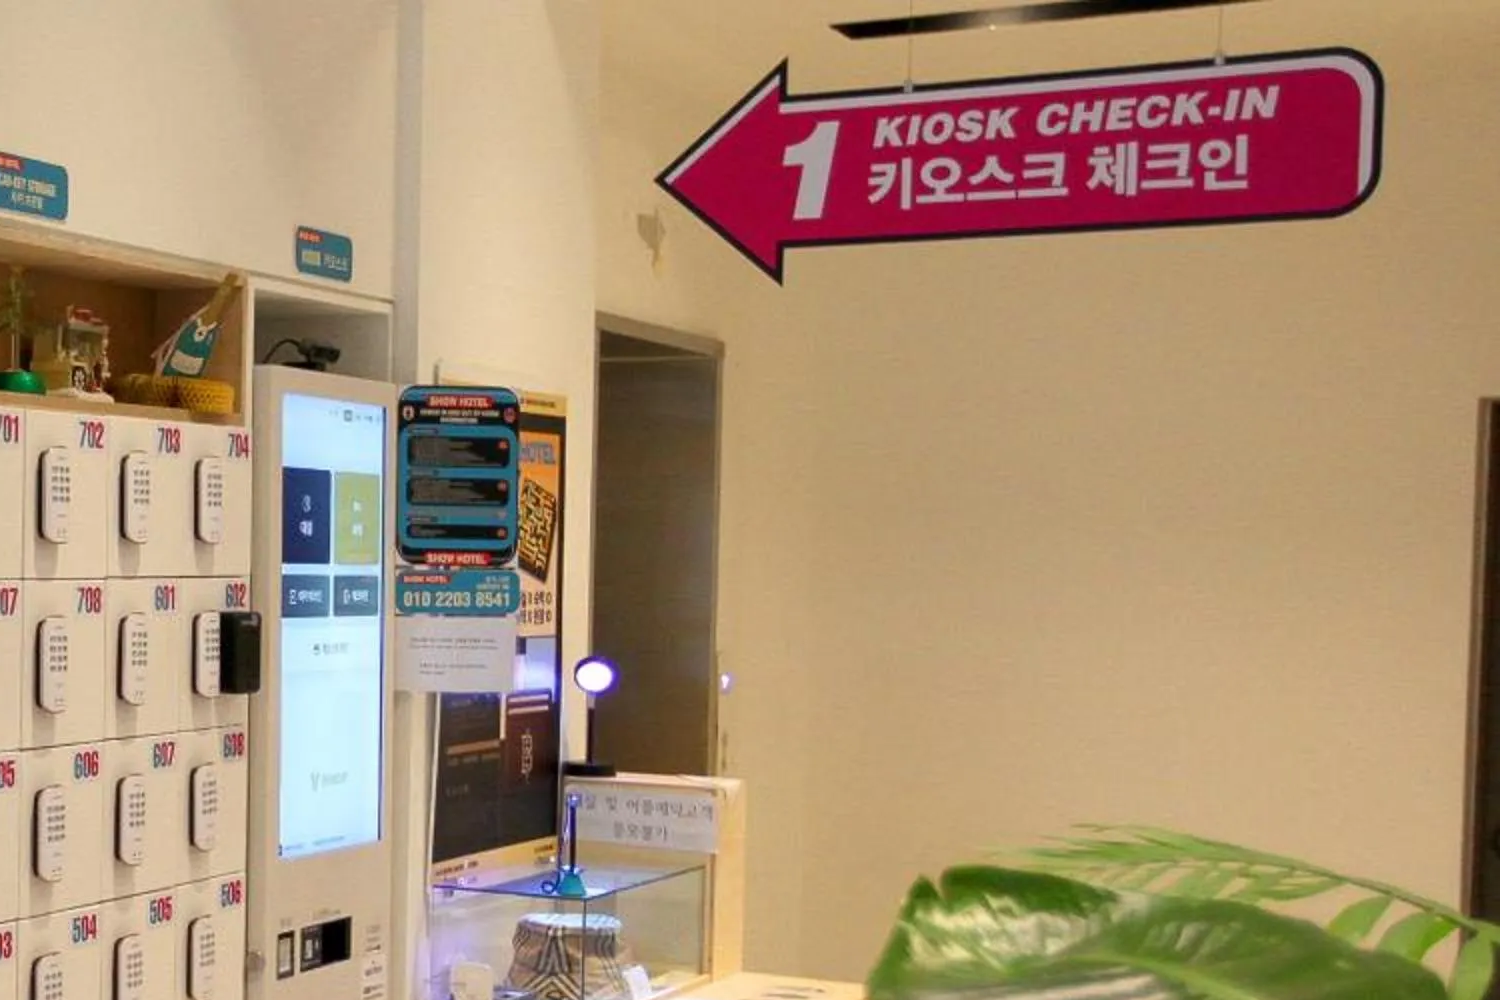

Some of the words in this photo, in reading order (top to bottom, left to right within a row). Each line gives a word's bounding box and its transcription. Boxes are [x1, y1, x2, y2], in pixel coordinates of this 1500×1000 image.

[873, 105, 1020, 149] KIOSK
[1036, 85, 1280, 136] CHECK-IN
[782, 120, 840, 220] 1
[867, 151, 1069, 210] 키오스크
[1086, 133, 1248, 197] 체크인
[79, 421, 104, 449] 702
[157, 427, 181, 454] 703
[228, 433, 249, 459] 704
[77, 587, 101, 614] 708
[154, 585, 176, 610] 601
[225, 584, 246, 608] 602
[403, 591, 431, 607] 010
[434, 591, 471, 607] 2203
[475, 591, 510, 608] 8541
[153, 742, 175, 769] 607
[222, 732, 244, 759] 608
[74, 751, 99, 780] 606
[220, 881, 242, 907] 506
[150, 896, 173, 925] 505
[71, 914, 98, 944] 504
